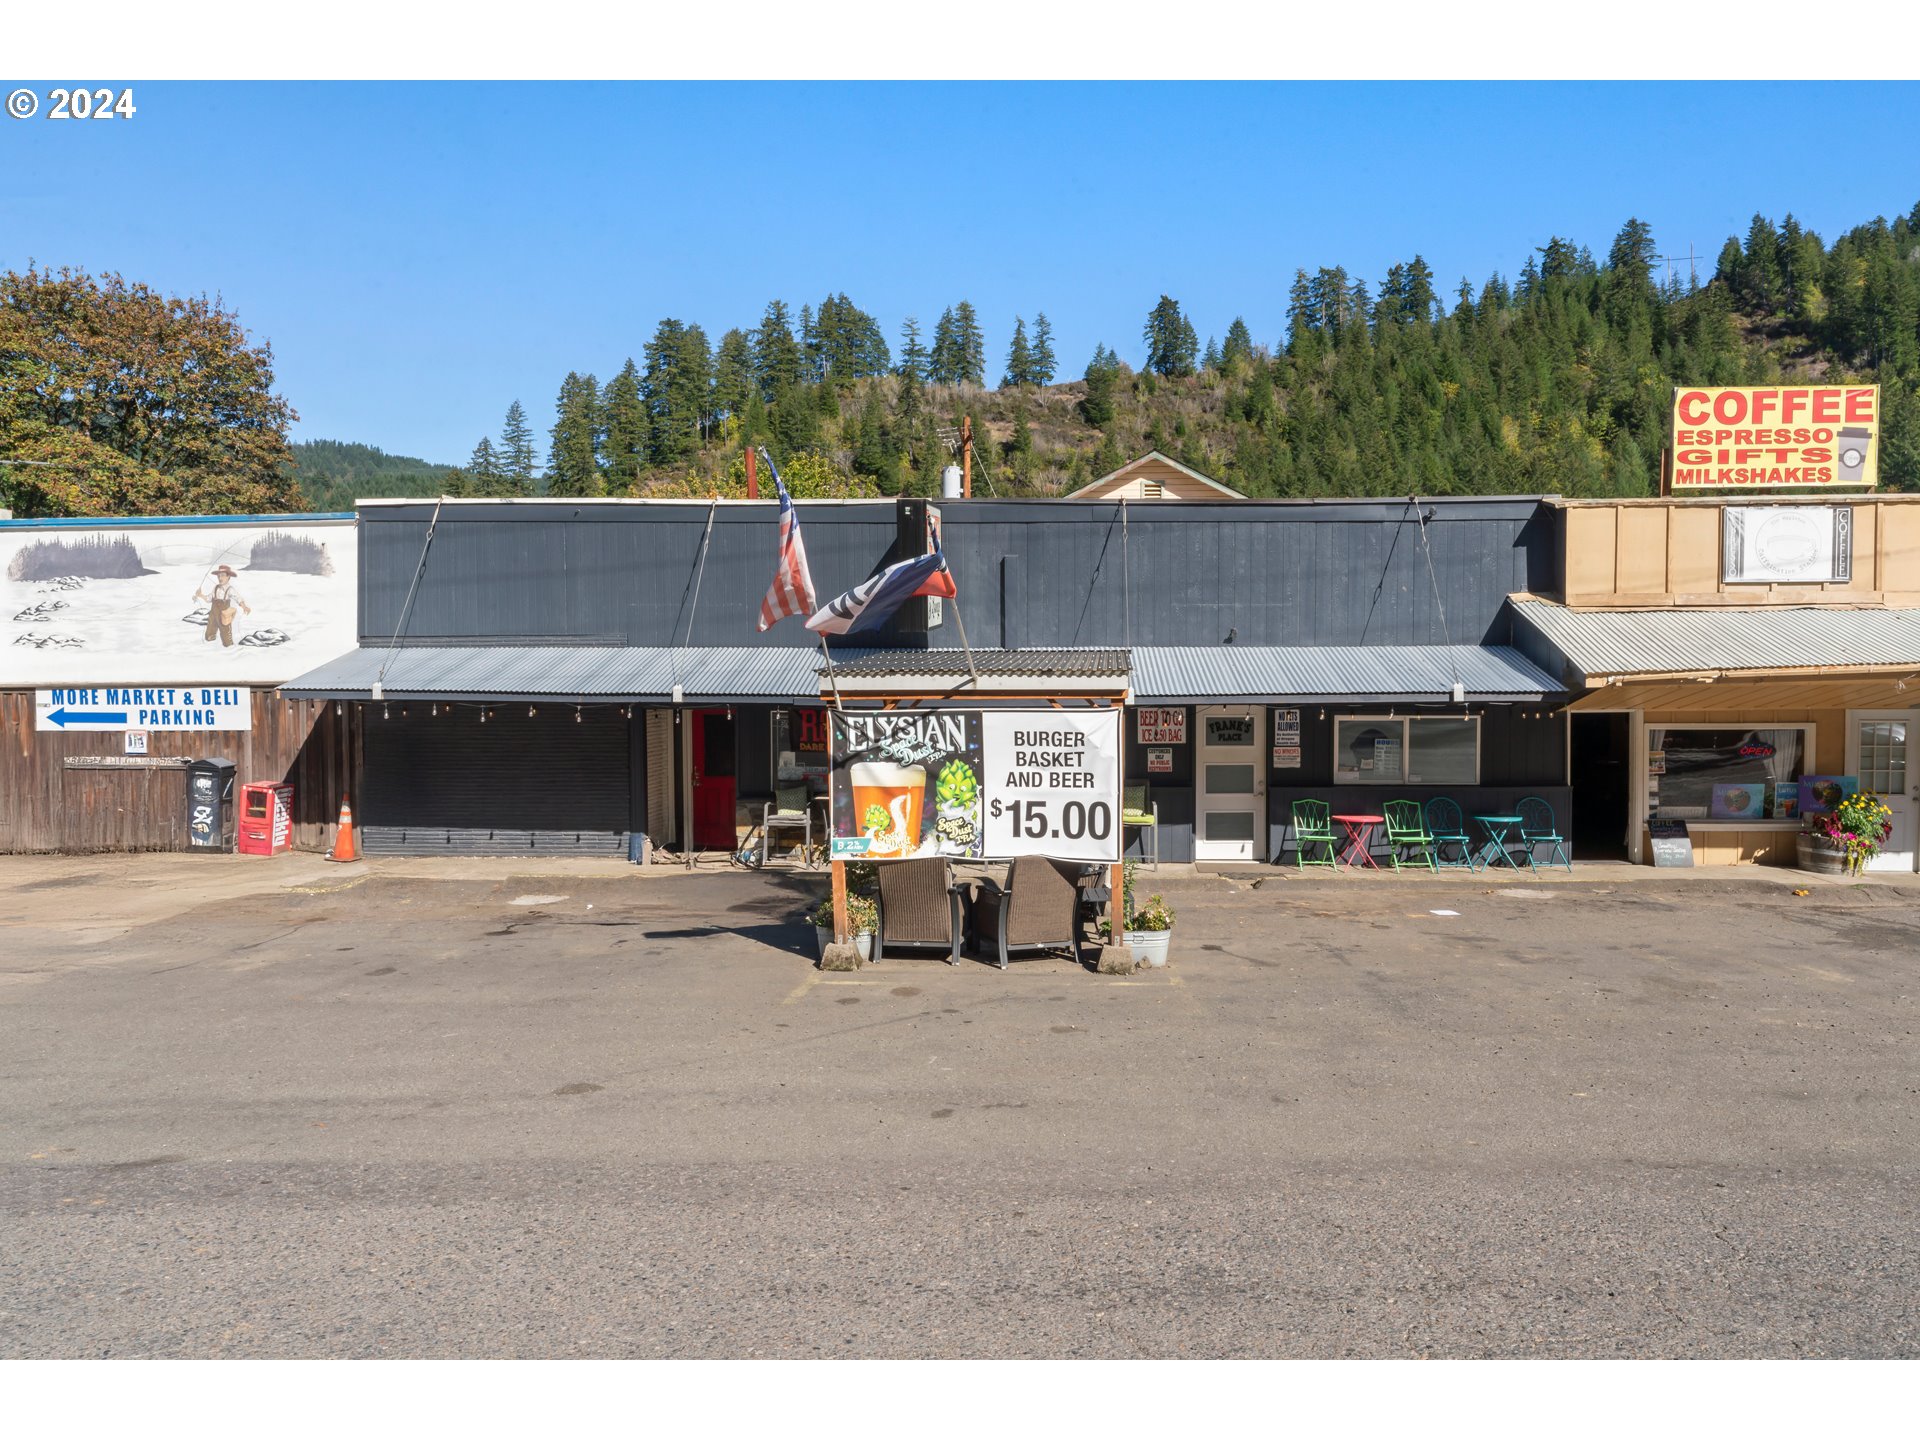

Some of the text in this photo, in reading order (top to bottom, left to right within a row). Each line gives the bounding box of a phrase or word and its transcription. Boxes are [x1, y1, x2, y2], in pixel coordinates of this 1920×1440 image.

[1679, 389, 1874, 426] COFFEE
[1677, 428, 1833, 446] ESPRESSO
[1677, 447, 1833, 465] GIFTS
[1675, 467, 1832, 484] MILKSHAKES
[1839, 511, 1848, 576] COFFEE
[52, 689, 238, 706] MORE MARKET & DELI
[139, 709, 215, 725] PARKING
[1140, 710, 1184, 726] BEER TO GO
[1278, 711, 1285, 721] NO
[846, 714, 967, 753] ELYSIAN
[1209, 720, 1252, 733] FRANK'S
[1277, 721, 1299, 732] ALLOWED
[1014, 731, 1085, 748] BURGER
[1141, 729, 1153, 742] ICE
[1168, 729, 1182, 742] BAG
[1218, 733, 1243, 742] PLACE
[879, 734, 919, 760] Space
[898, 740, 936, 768] Dust
[1739, 746, 1773, 756] OPEN
[1016, 751, 1085, 767] BASKET
[1005, 771, 1095, 789] AND BEER
[990, 797, 1112, 841] $15.00
